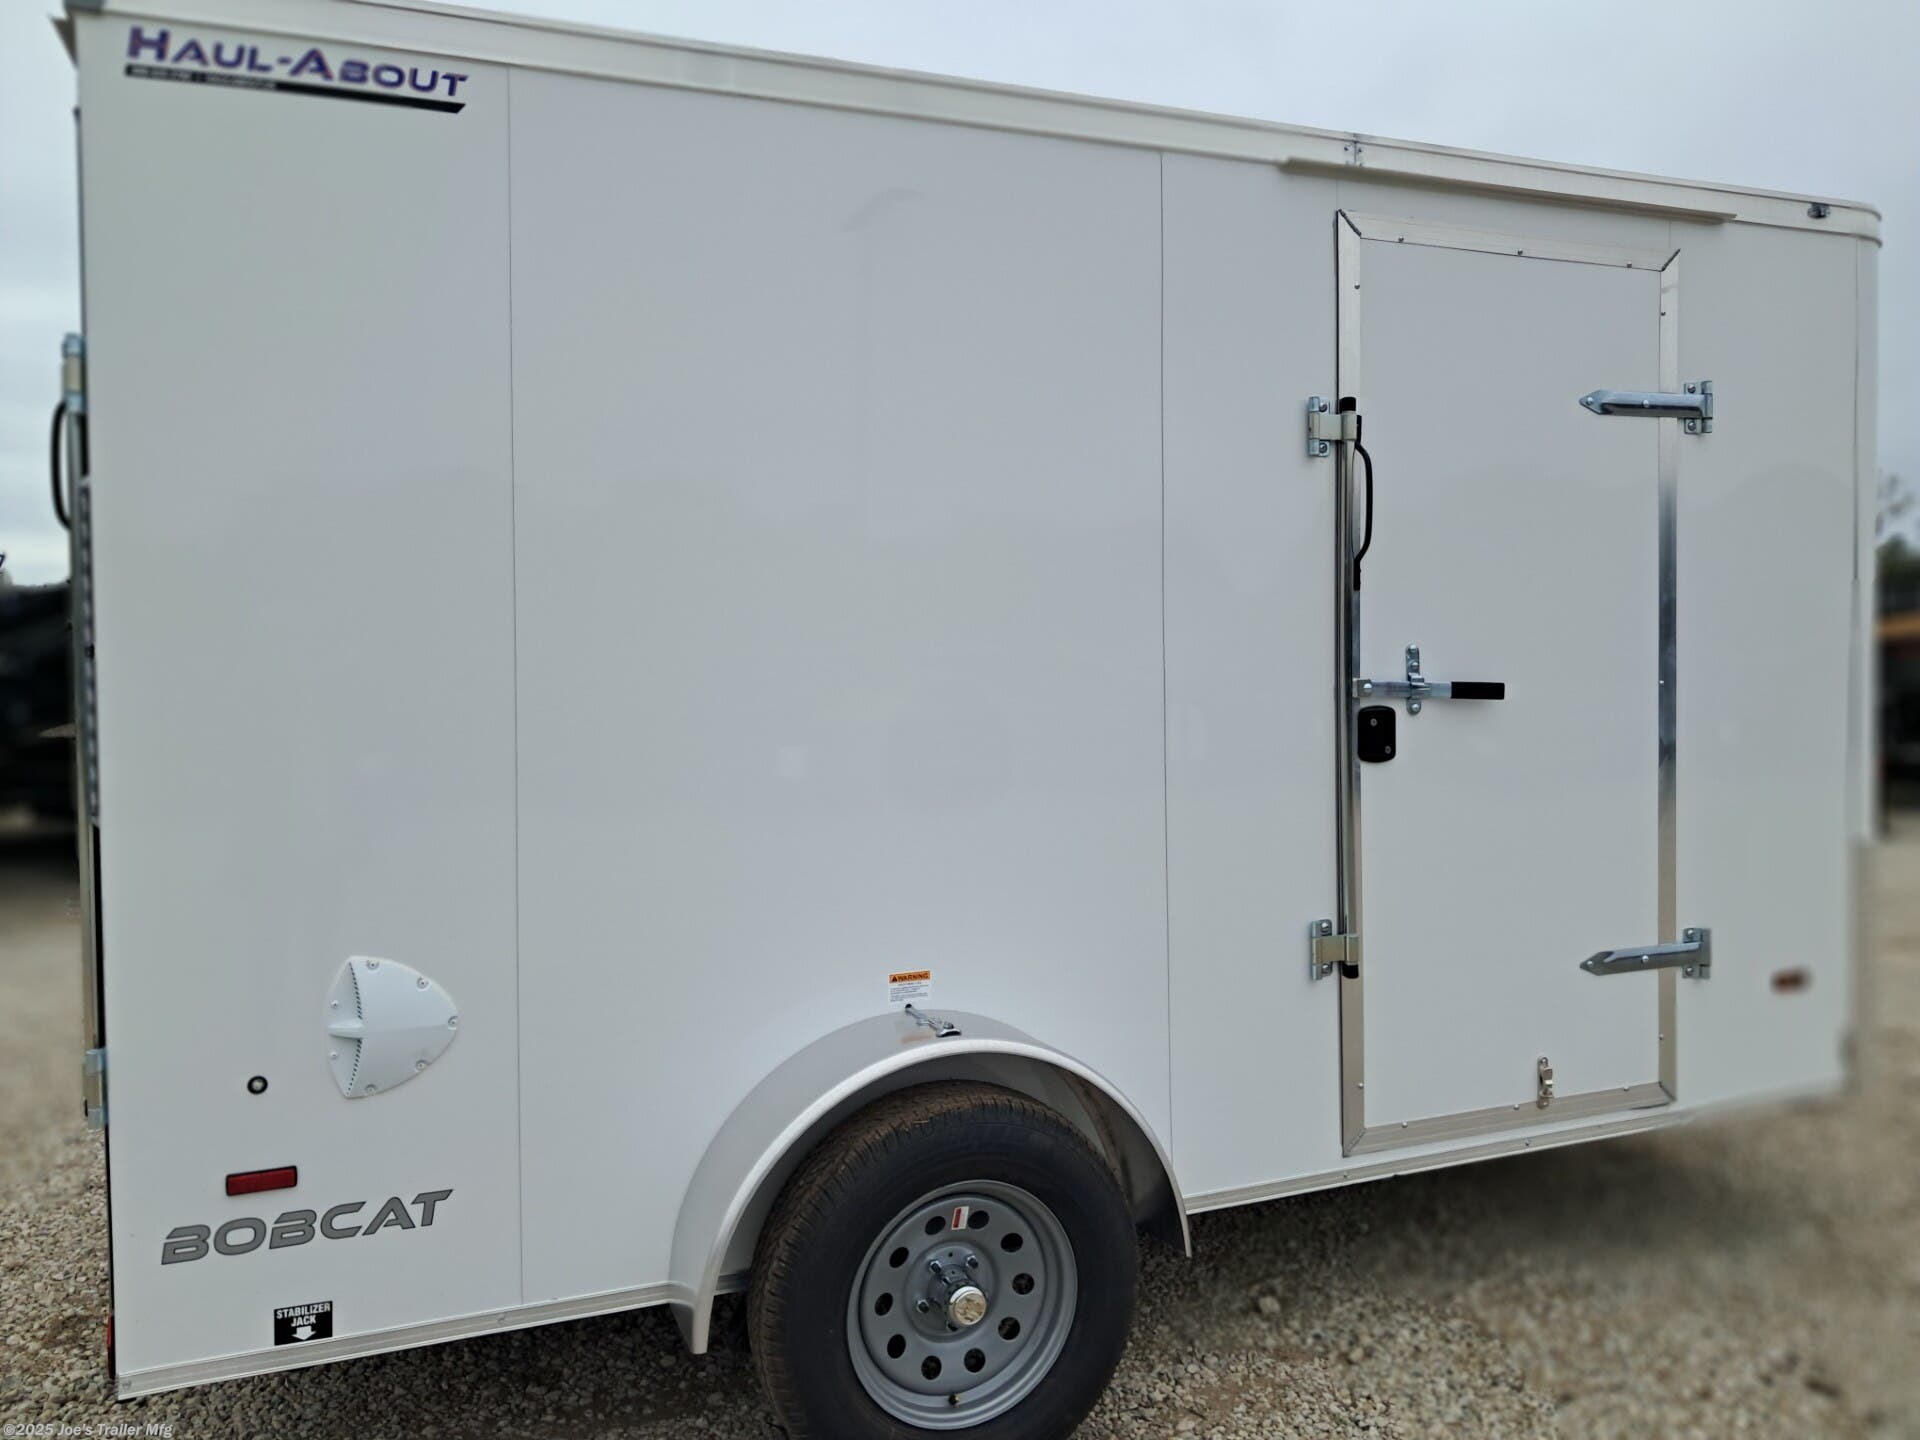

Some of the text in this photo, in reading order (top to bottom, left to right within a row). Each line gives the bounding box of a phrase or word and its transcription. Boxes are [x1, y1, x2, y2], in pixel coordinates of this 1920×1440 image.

[897, 972, 929, 982] WARNING
[160, 1188, 454, 1266] BOBCAT
[276, 1302, 331, 1320] STABILIZER
[290, 1314, 317, 1327] JACK
